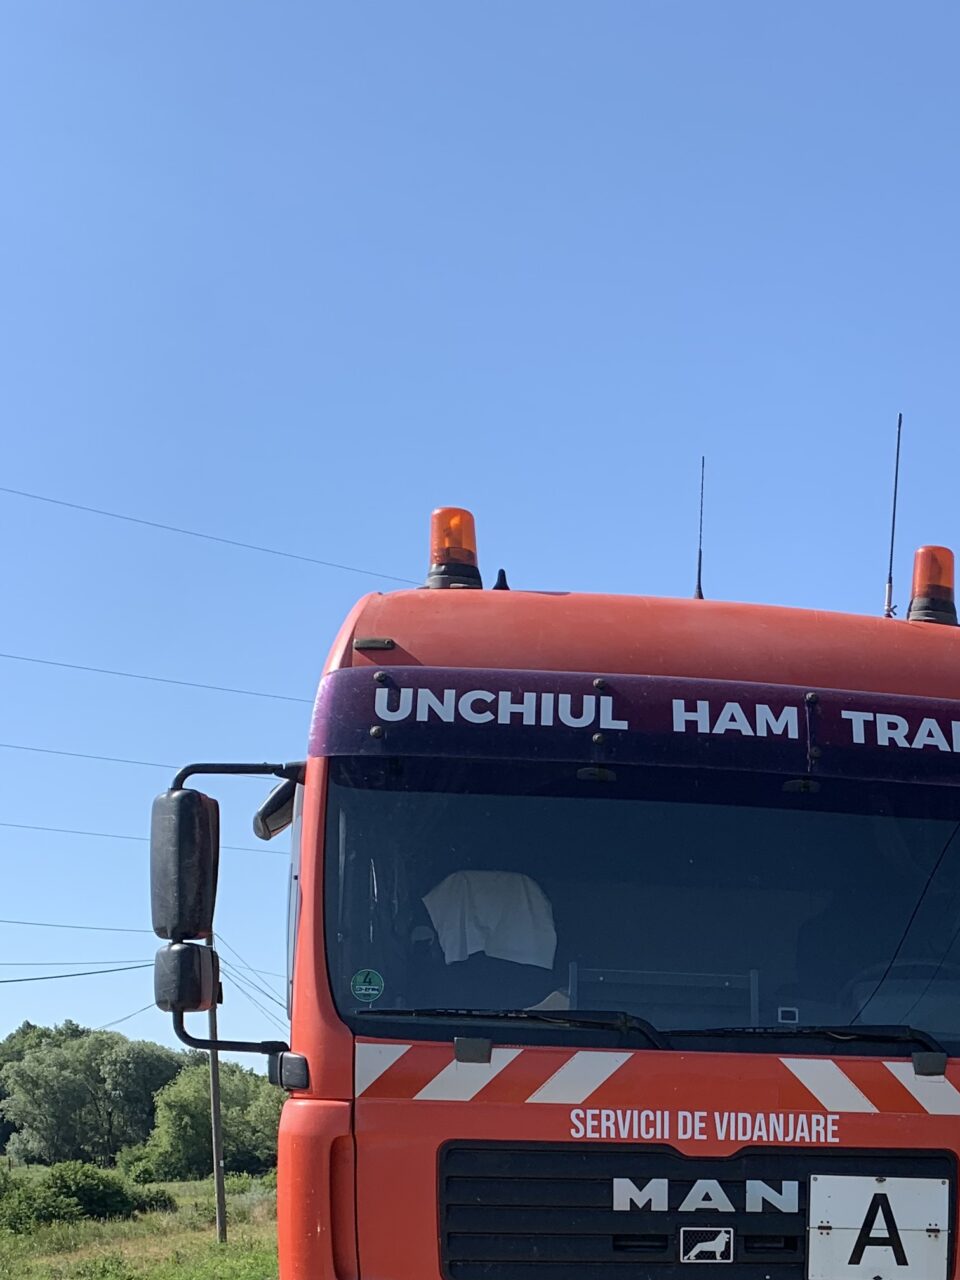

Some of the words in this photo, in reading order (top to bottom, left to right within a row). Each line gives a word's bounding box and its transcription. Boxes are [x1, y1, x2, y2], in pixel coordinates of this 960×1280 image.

[374, 687, 628, 731] UNCHIUL
[673, 699, 798, 739] HAM
[363, 971, 373, 985] 4
[569, 1109, 670, 1140] SERVICII
[677, 1111, 707, 1140] DE
[714, 1111, 840, 1143] VIDANJARE
[612, 1177, 799, 1213] MAN
[847, 1192, 909, 1267] A
